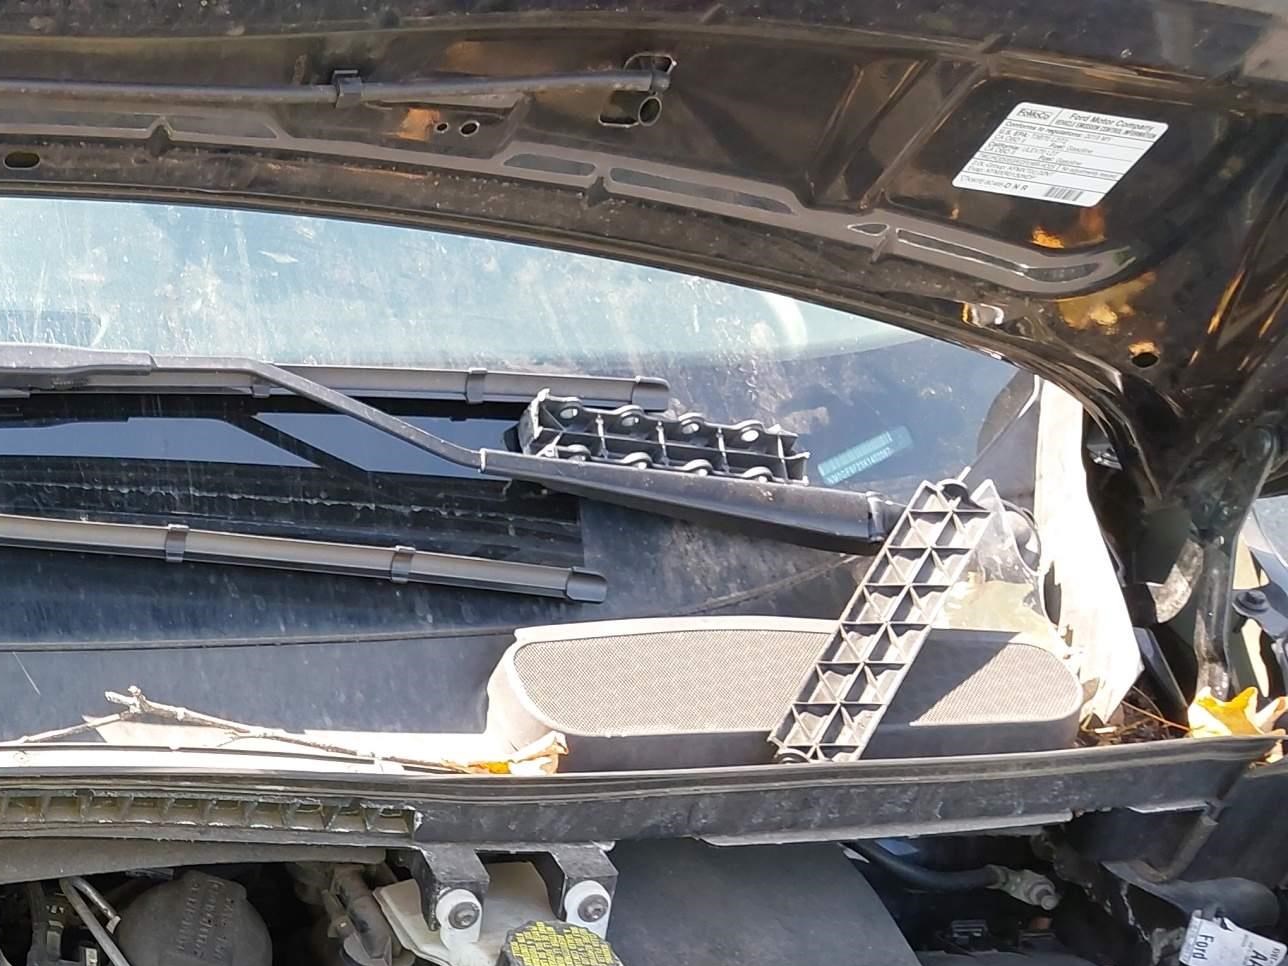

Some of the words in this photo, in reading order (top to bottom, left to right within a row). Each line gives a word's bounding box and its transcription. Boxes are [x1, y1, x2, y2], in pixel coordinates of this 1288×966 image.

[1017, 107, 1052, 121] FoMoCo
[1070, 112, 1090, 122] Ford
[1091, 115, 1115, 127] Motor
[1114, 119, 1156, 132] Company
[1192, 934, 1215, 961] Ford
